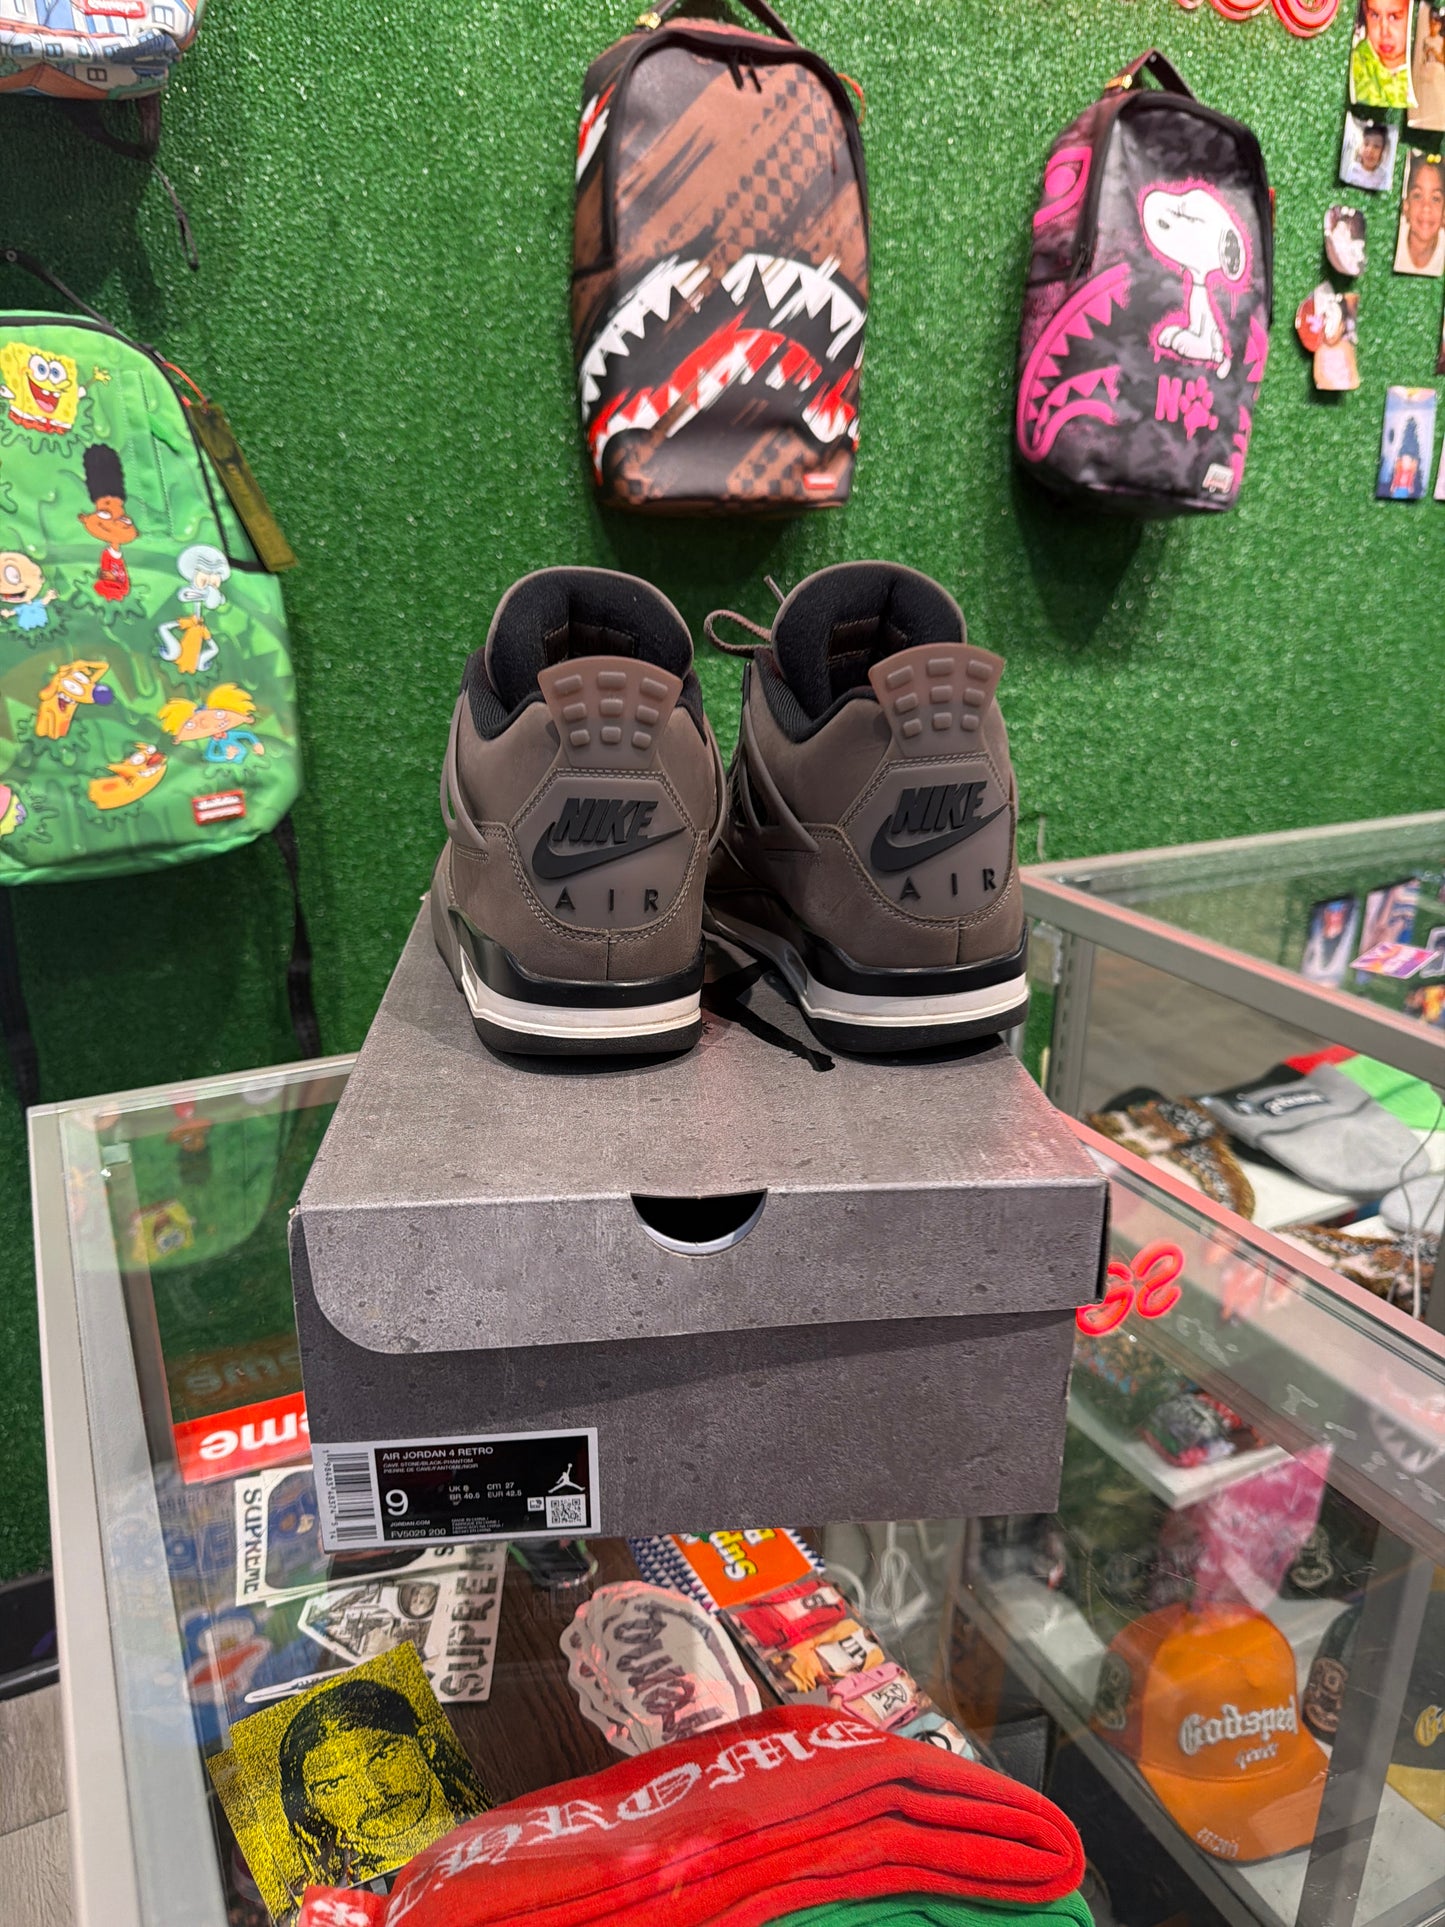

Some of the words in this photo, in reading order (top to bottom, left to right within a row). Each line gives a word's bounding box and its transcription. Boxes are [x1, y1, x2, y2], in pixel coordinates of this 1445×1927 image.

[552, 797, 659, 847] NIKE
[890, 780, 987, 836] NIKE
[899, 868, 997, 901] AIR
[554, 886, 659, 912] AIR
[382, 1452, 400, 1461] AIR
[403, 1449, 446, 1460] JORDAN
[449, 1448, 455, 1457] 4
[458, 1446, 494, 1456] RETRO
[385, 1488, 409, 1516] 9
[505, 1489, 522, 1497] 42.5
[390, 1520, 431, 1528] JORDAN.COM
[391, 1529, 426, 1539] FV5029
[428, 1528, 446, 1537] 200
[243, 1487, 263, 1596] SUPREME
[439, 1544, 499, 1697] SUPREM
